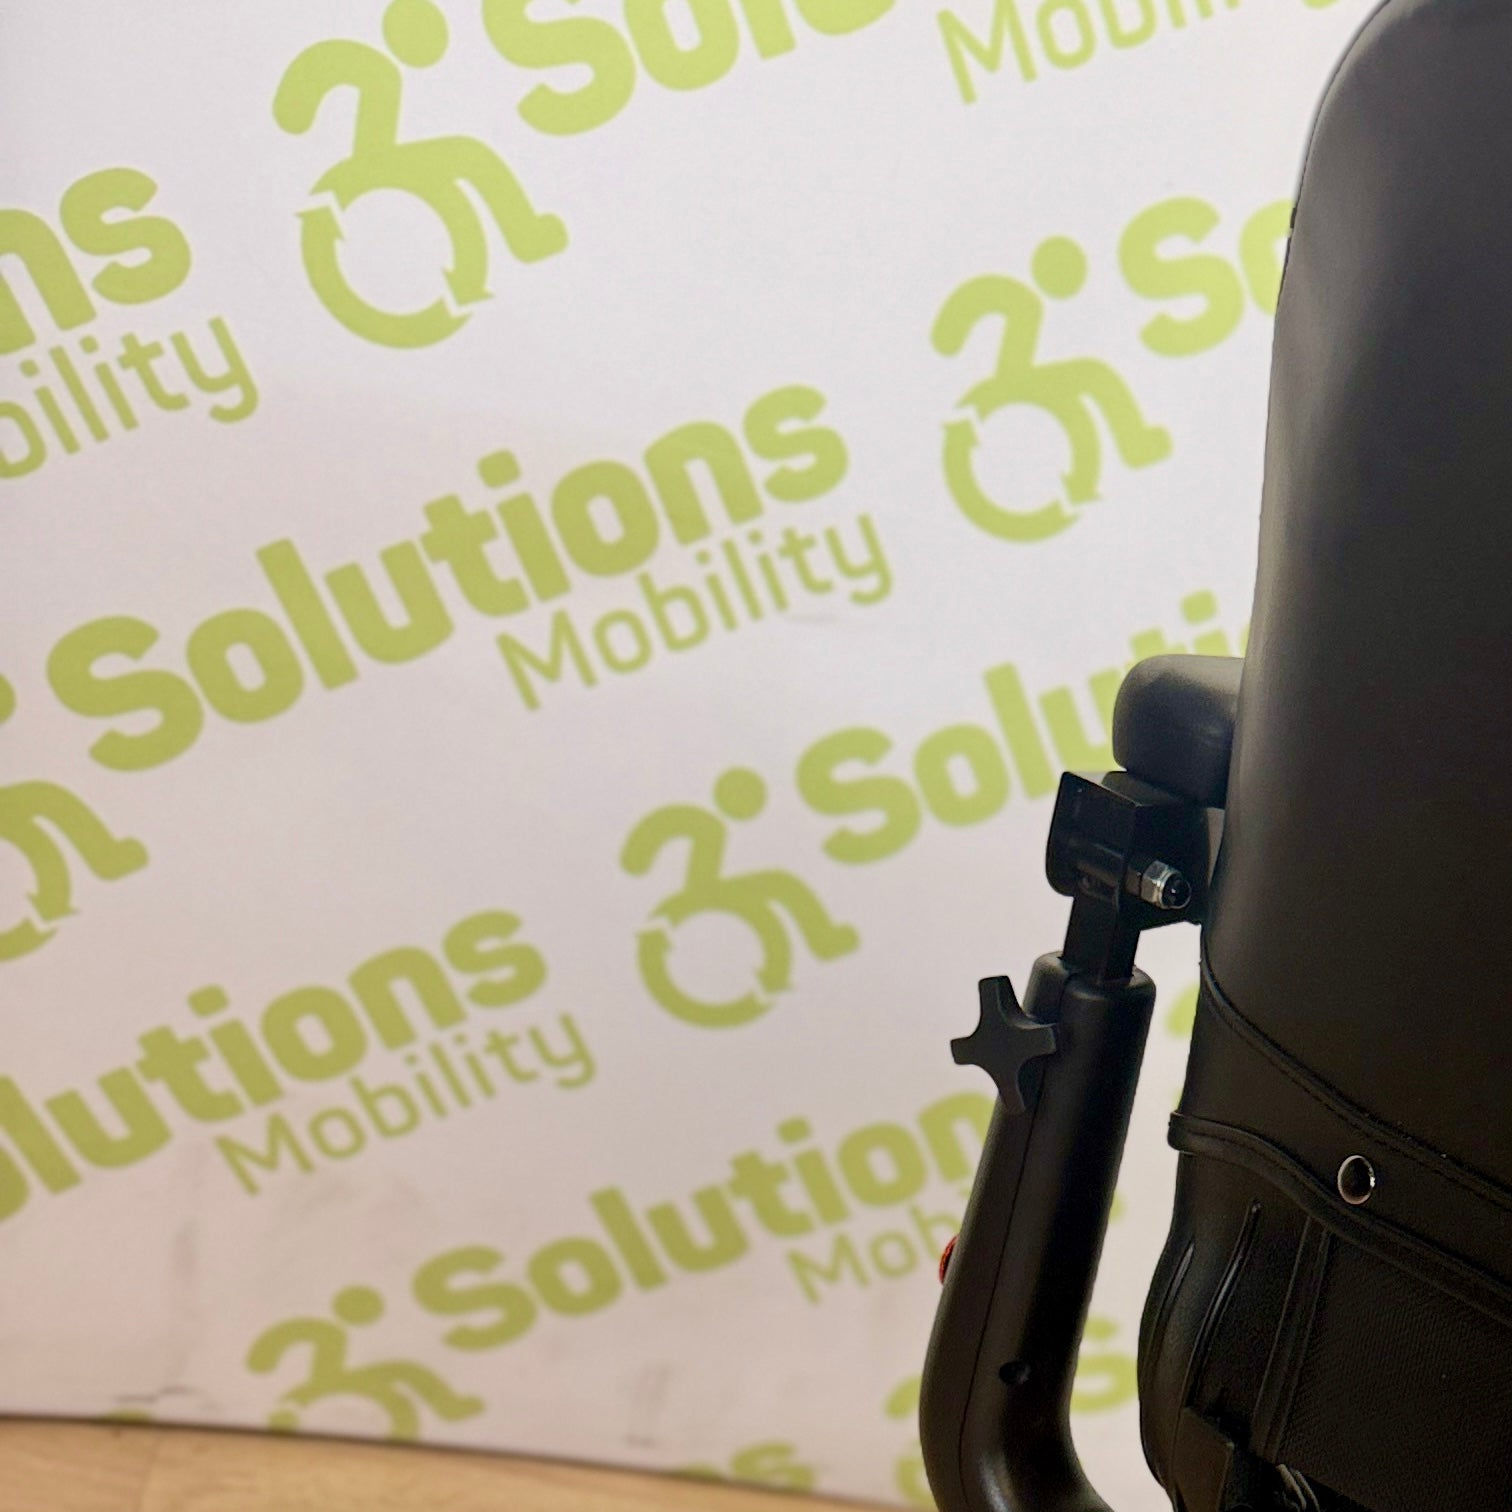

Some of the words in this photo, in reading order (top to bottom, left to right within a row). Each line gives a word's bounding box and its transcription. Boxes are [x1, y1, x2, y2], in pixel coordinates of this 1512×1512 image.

[45, 384, 849, 772] Solutions
[496, 513, 894, 712] Mobility
[0, 909, 548, 1223] lutions
[213, 1013, 597, 1196] Mobility
[412, 1091, 1003, 1352] Solution
